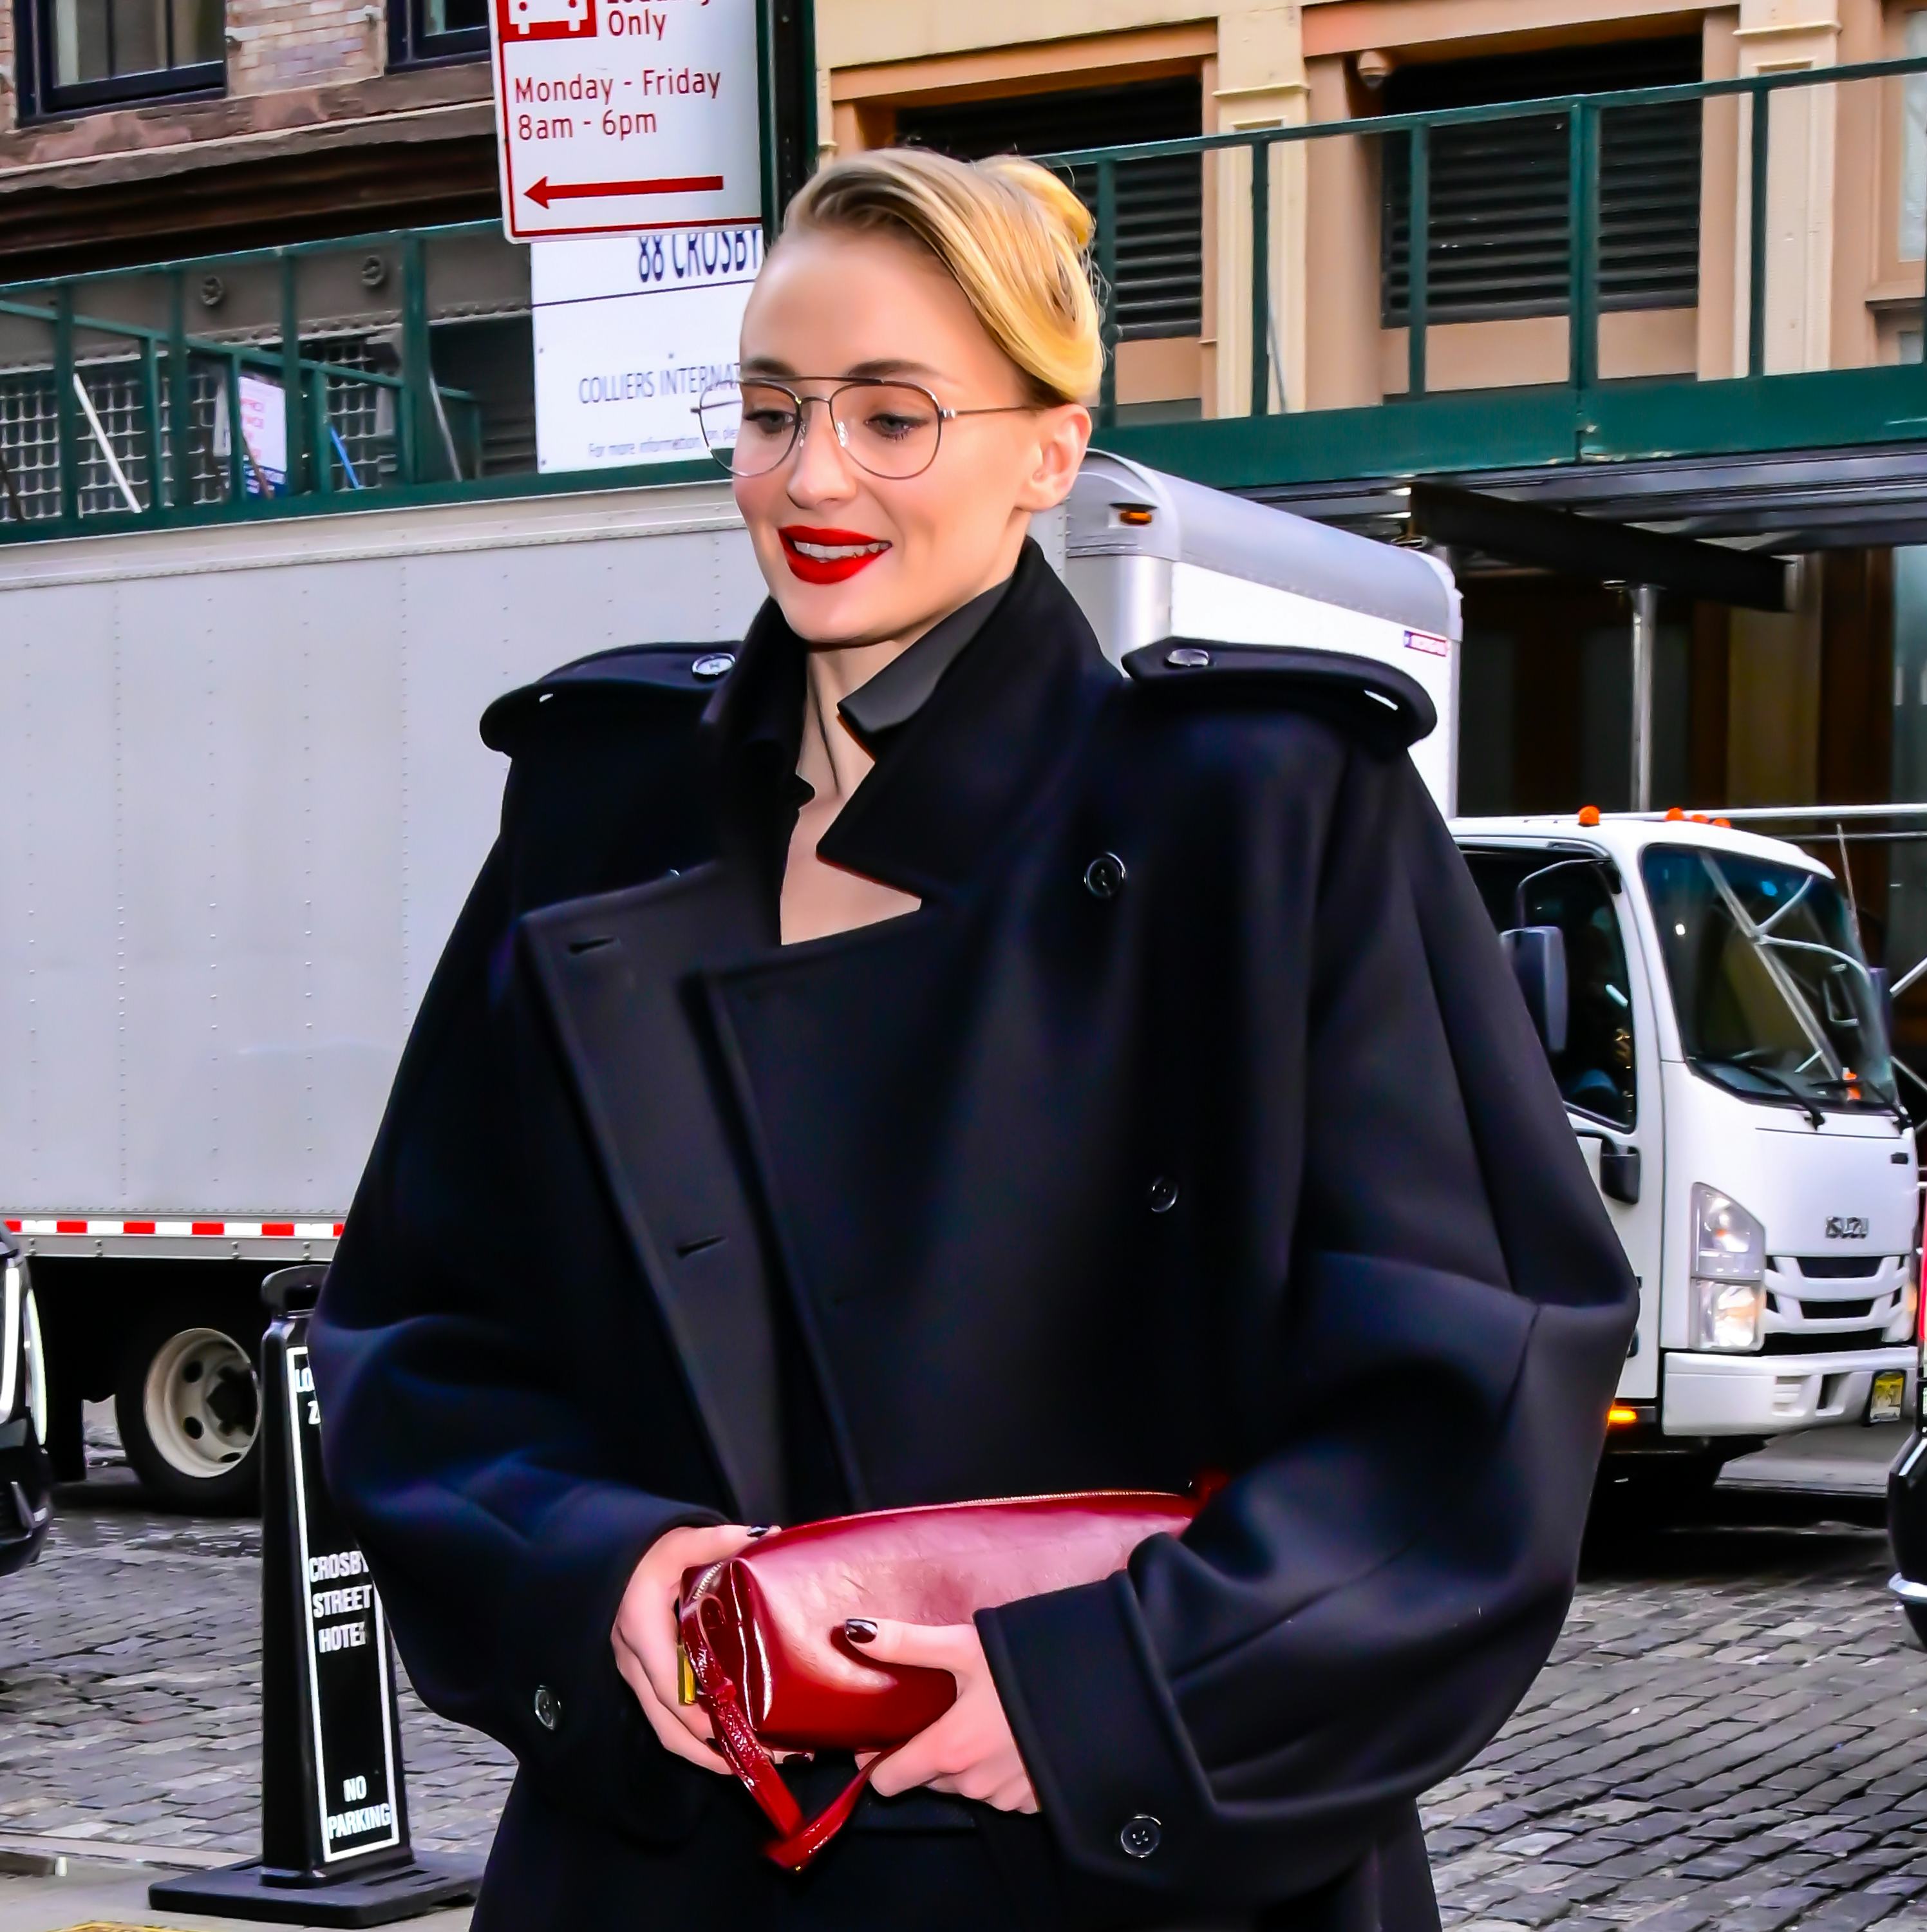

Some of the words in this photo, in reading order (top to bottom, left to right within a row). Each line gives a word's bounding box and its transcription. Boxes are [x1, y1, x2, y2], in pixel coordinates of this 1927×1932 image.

[608, 8, 667, 41] Only
[514, 73, 613, 105] Monday
[643, 68, 720, 99] Friday
[518, 114, 574, 140] 8am
[603, 109, 657, 141] 6pm
[579, 371, 654, 403] COLLIERS
[312, 1584, 373, 1618] STREET
[343, 1775, 367, 1802] NO
[327, 1803, 391, 1840] PARKING
